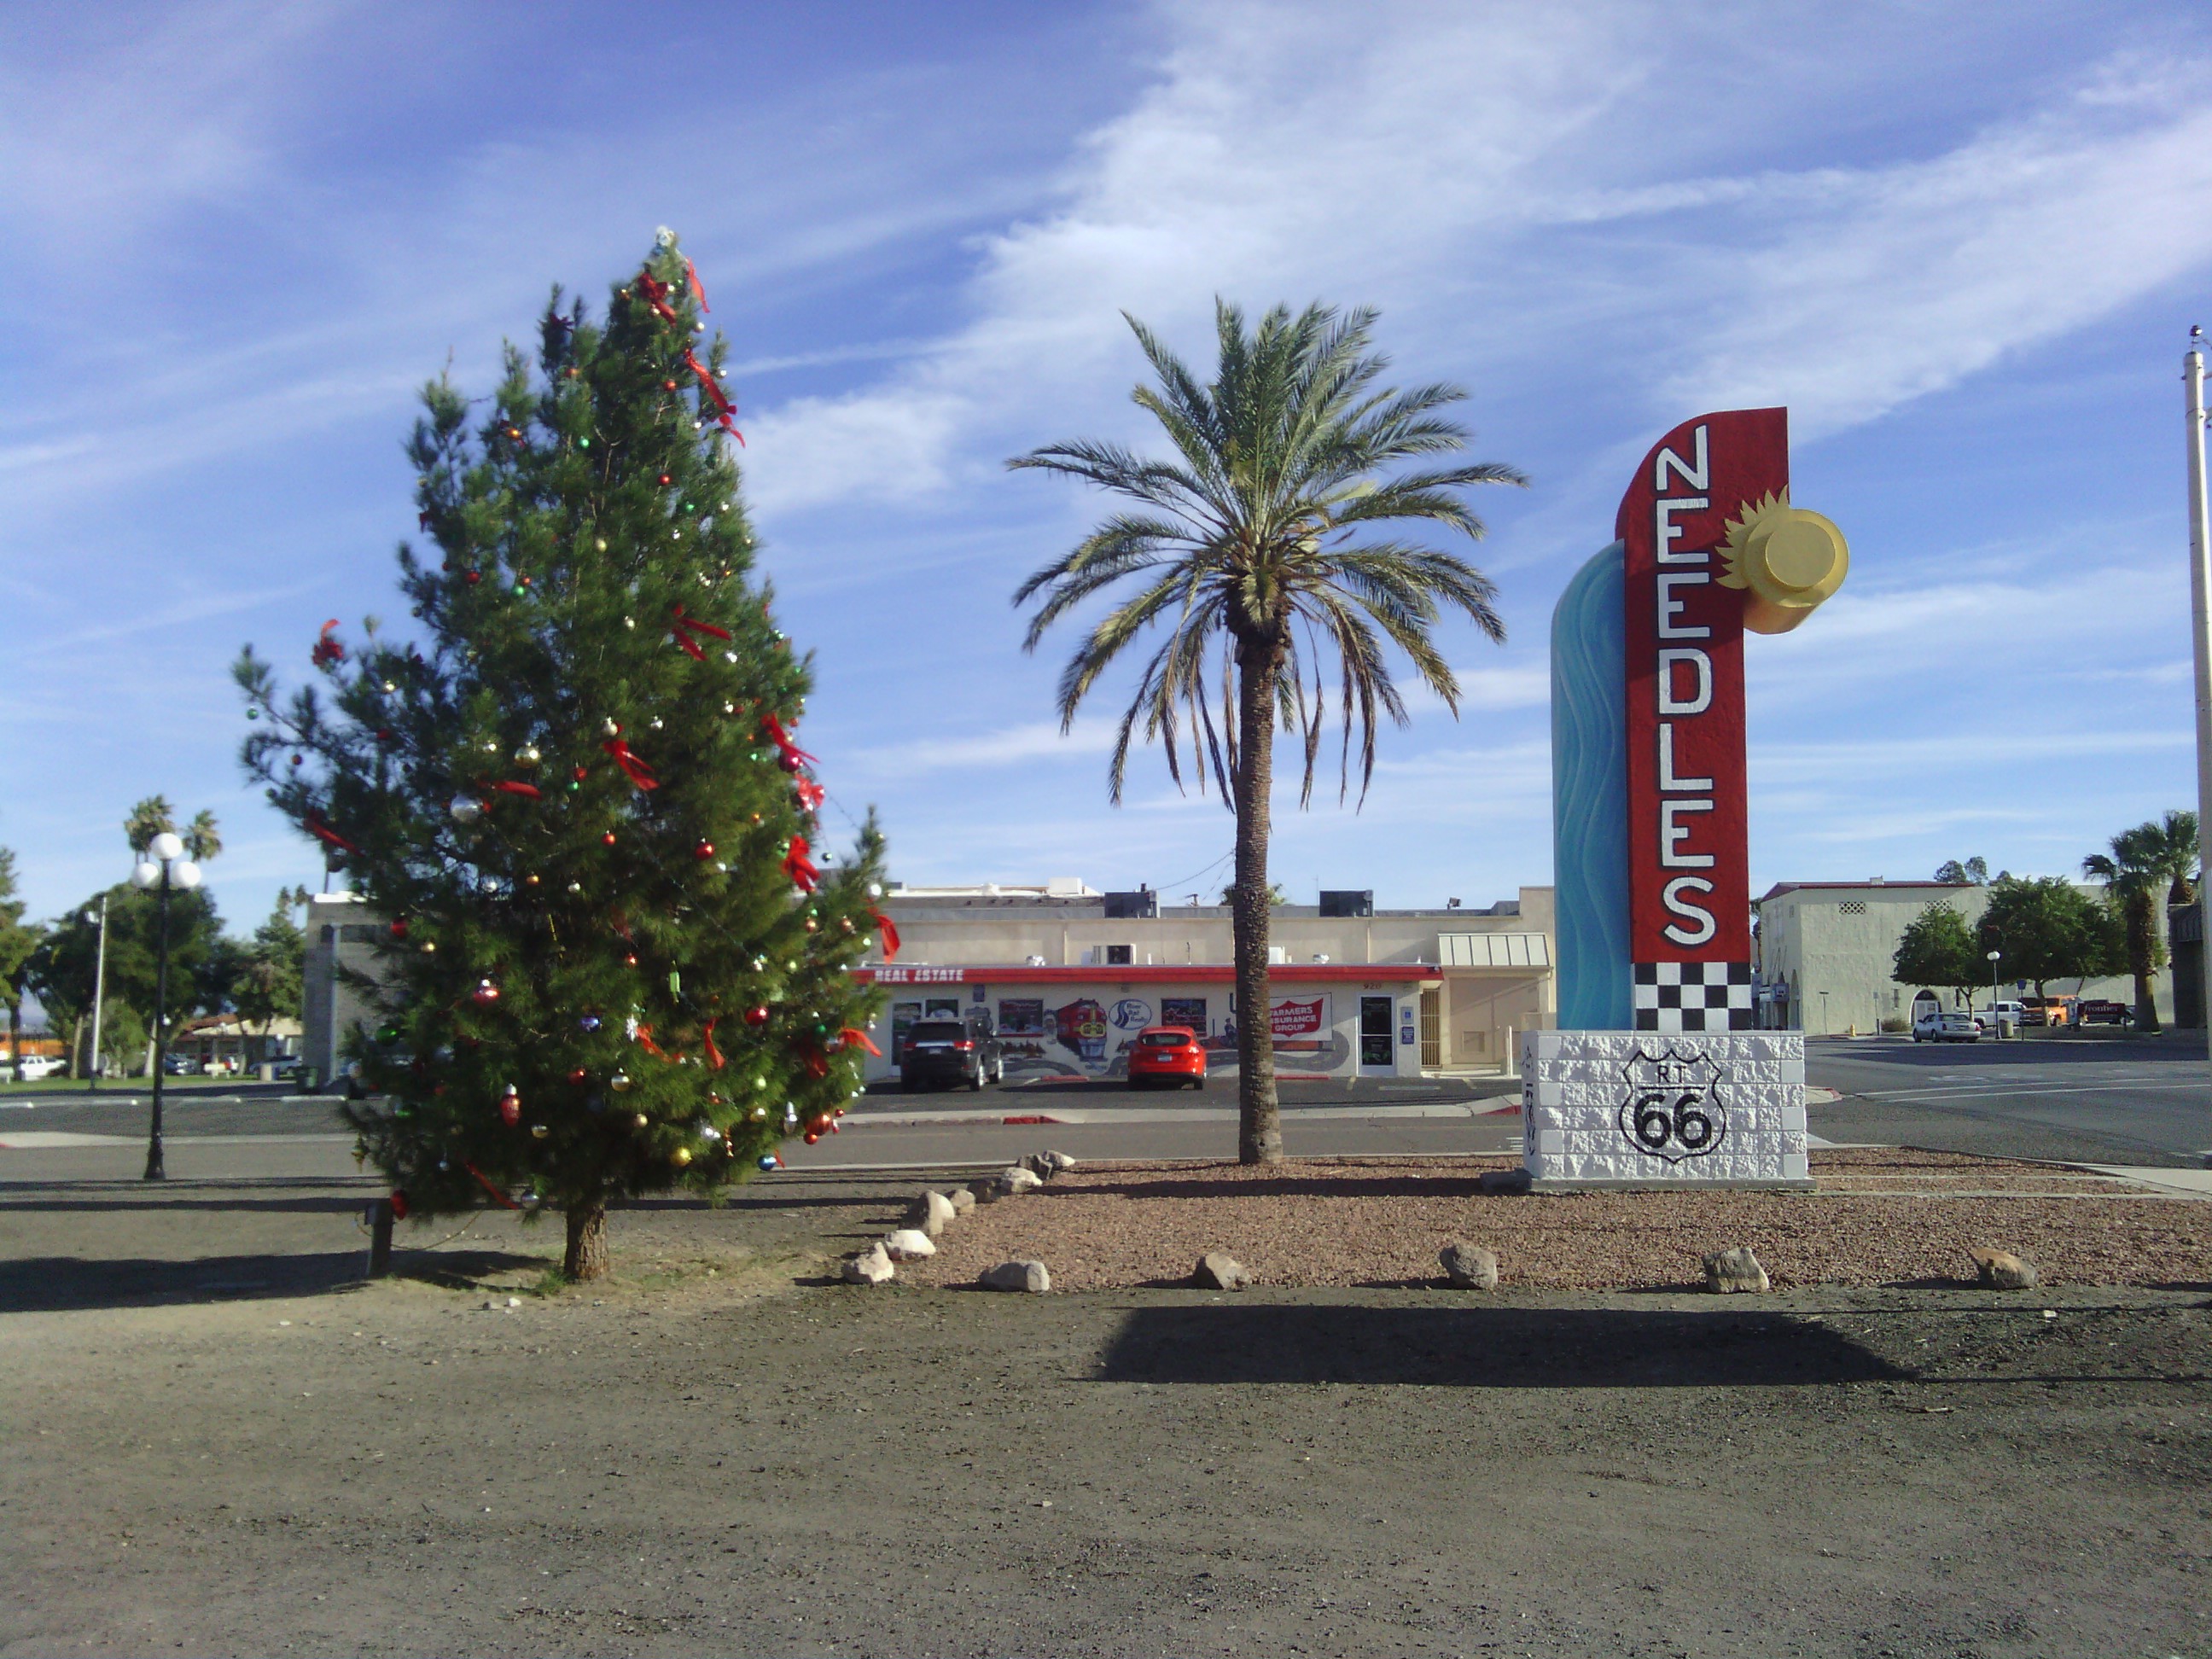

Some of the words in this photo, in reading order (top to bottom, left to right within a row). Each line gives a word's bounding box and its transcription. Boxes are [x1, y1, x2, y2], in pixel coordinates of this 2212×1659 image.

[1656, 425, 1715, 945] NEEDLES
[875, 969, 908, 981] REAL
[914, 969, 963, 981] ESTATE
[1657, 1066, 1687, 1083] RT
[1633, 1094, 1712, 1149] 66
